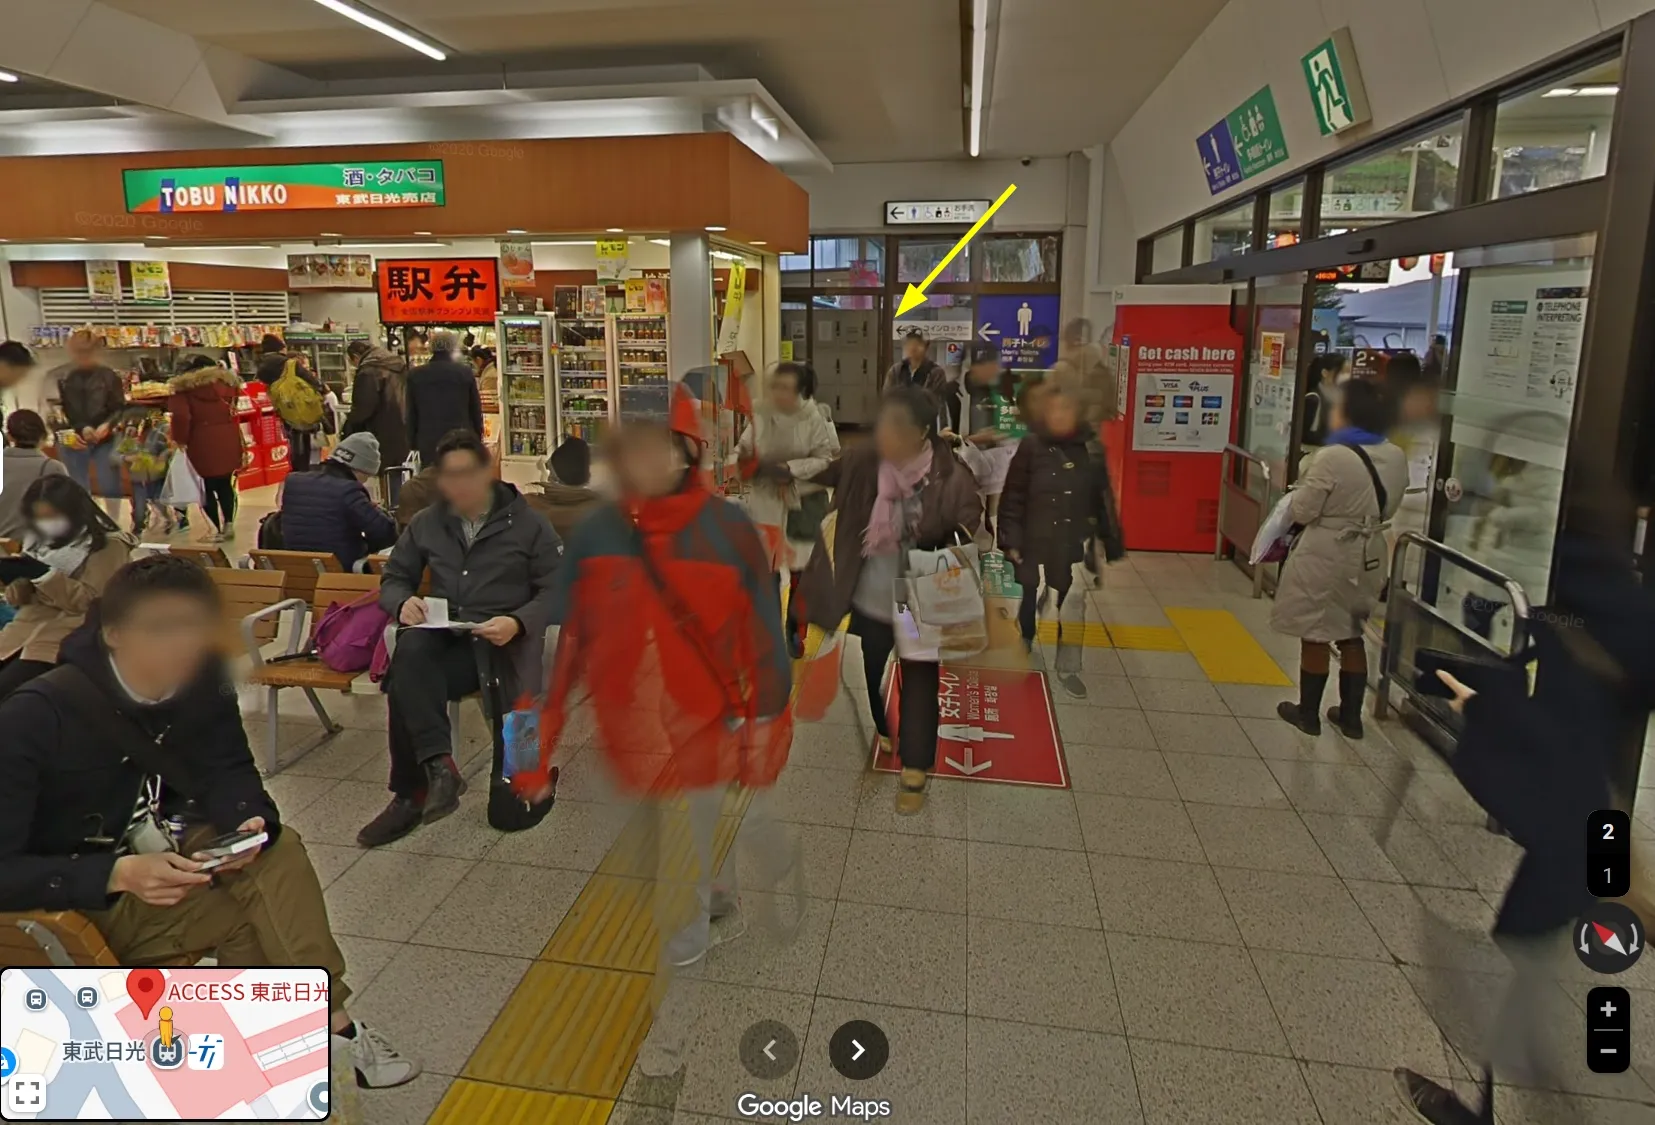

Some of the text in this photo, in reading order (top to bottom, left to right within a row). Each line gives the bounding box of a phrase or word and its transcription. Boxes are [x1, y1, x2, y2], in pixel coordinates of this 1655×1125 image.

[343, 167, 436, 187] 酒・タバコ
[161, 184, 288, 207] TOBU NIKKO
[335, 192, 437, 206] 東武日光売店
[387, 265, 488, 302] 駅弁
[1138, 346, 1235, 361] Get cash here
[938, 672, 960, 719] 女子トイレ
[967, 690, 980, 720] Women's
